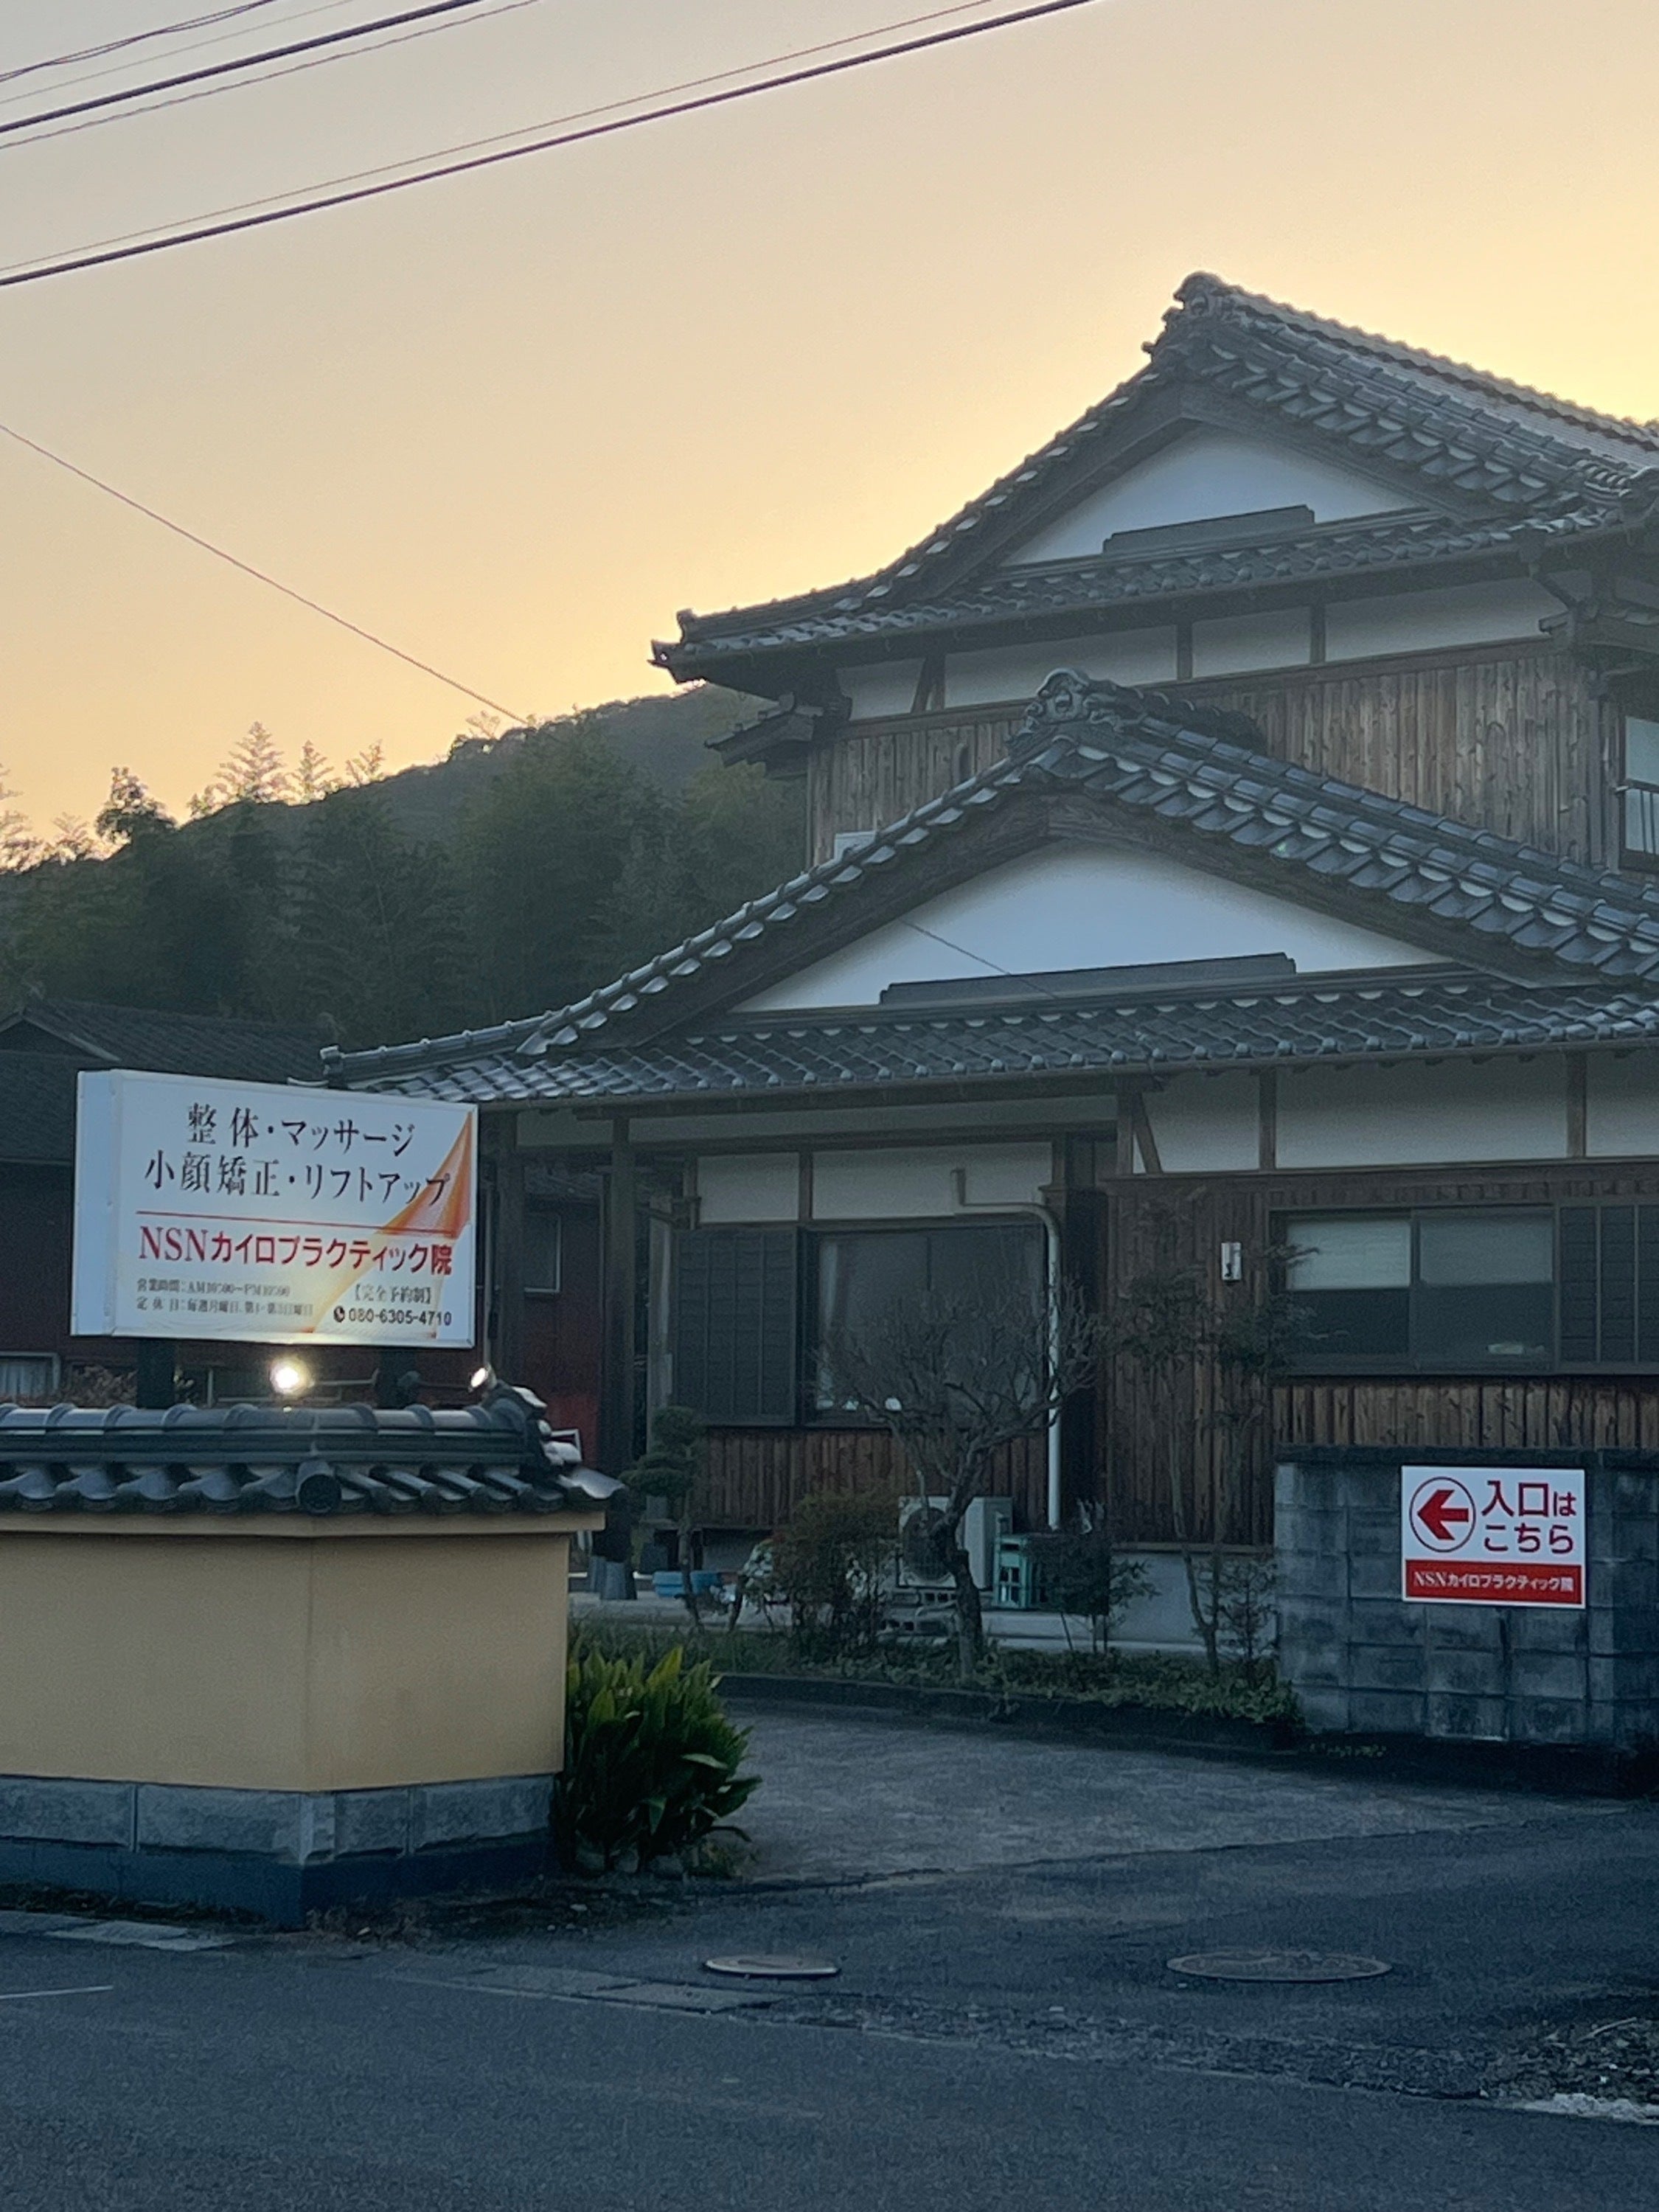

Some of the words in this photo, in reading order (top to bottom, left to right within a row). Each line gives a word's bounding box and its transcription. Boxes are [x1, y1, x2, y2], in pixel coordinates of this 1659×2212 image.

[139, 1225, 452, 1276] NSNカイロプラクティック院
[349, 1307, 452, 1326] 080-6305-4710
[1481, 1480, 1577, 1518] 入口は
[1484, 1523, 1573, 1554] こちら
